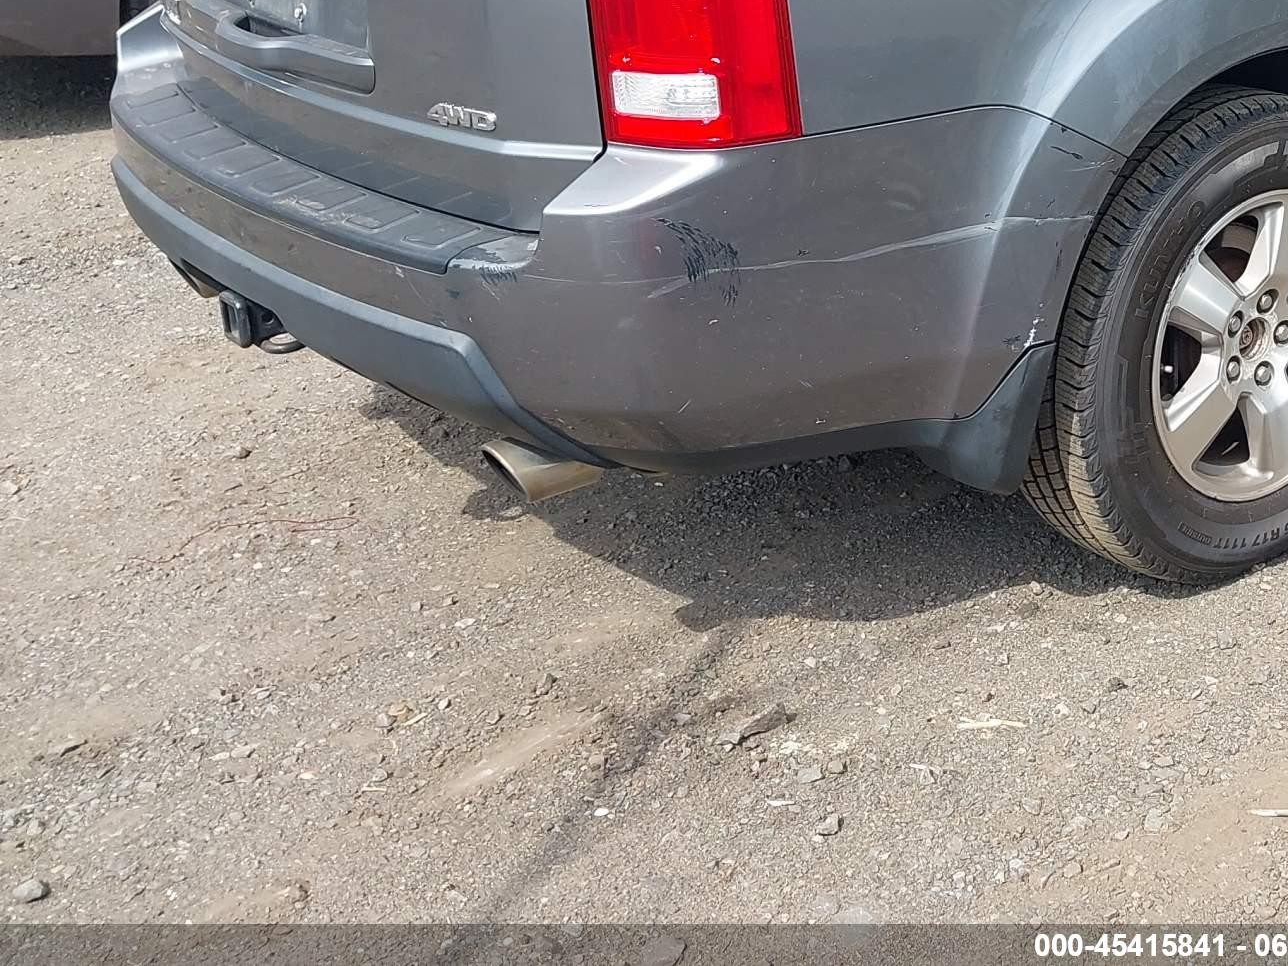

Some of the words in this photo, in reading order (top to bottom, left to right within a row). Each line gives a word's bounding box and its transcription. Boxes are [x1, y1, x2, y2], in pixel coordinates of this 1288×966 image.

[426, 102, 497, 132] 4WD
[1213, 536, 1247, 550] 111T
[1251, 530, 1281, 548] R17
